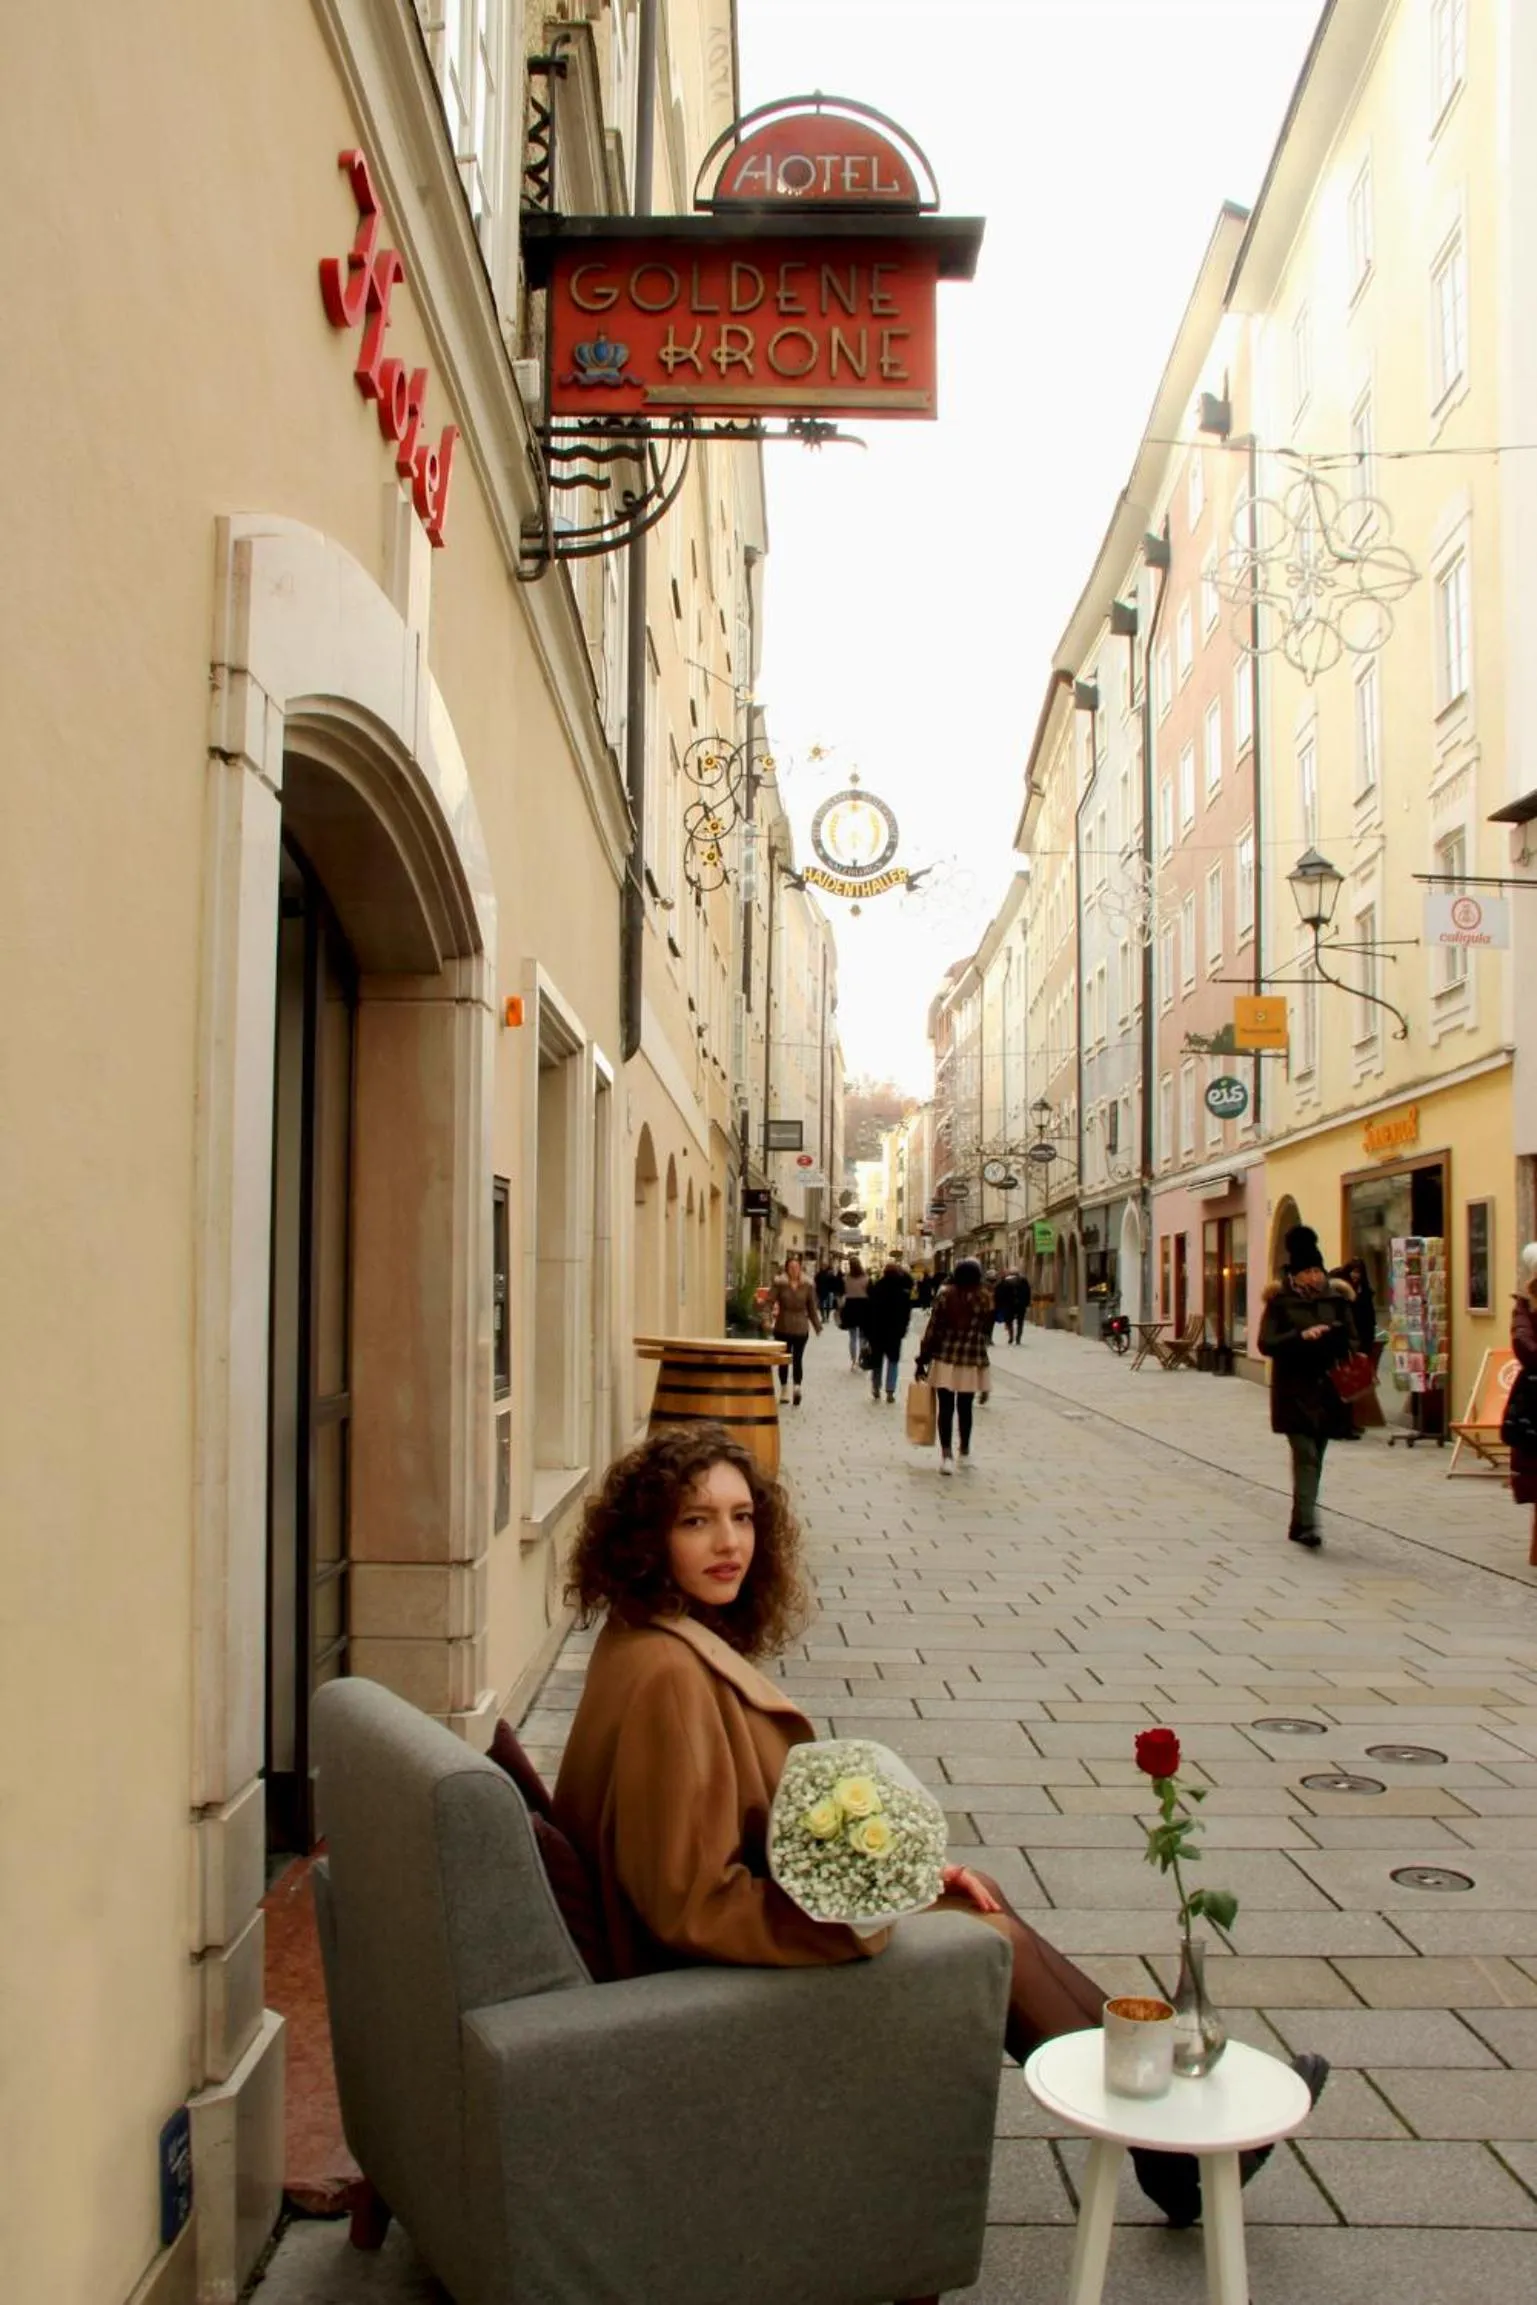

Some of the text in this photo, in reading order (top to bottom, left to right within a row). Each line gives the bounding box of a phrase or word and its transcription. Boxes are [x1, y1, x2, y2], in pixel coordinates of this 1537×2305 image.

[733, 154, 899, 194] HOTEL
[569, 261, 901, 316] GOLDENE
[319, 149, 460, 548] Hotel
[658, 323, 911, 380] KRONE
[803, 866, 909, 897] HAIDENTHALLER
[1207, 1080, 1244, 1105] eis
